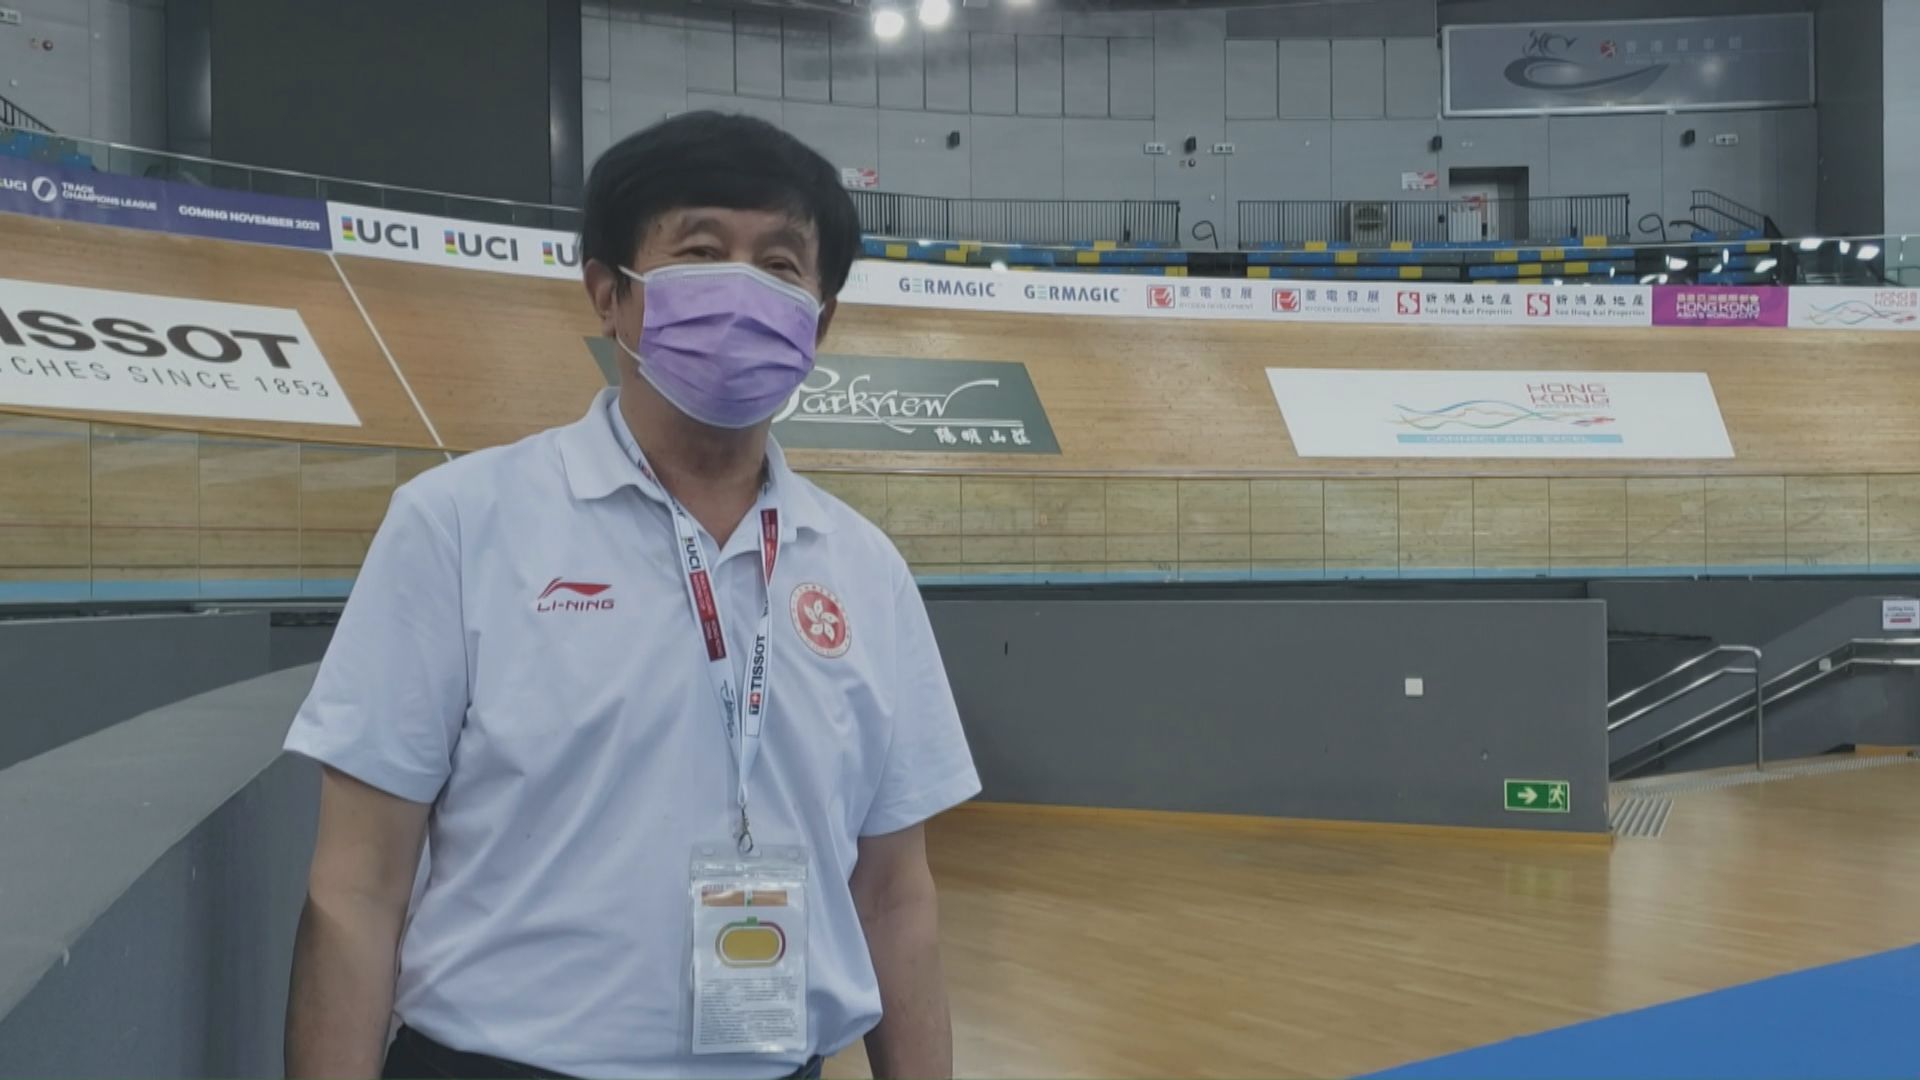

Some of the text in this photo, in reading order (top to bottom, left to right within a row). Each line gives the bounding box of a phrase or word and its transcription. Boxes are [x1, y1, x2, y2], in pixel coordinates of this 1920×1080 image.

[62, 182, 95, 193] TRACK
[62, 190, 157, 211] CHAMPIONS LEAGUE
[179, 205, 320, 232] COMING NOVEMBER 2021
[357, 218, 419, 250] UCI
[458, 232, 519, 262] UCI
[899, 277, 997, 298] GERMAGIC
[1024, 284, 1121, 303] GERMAGIC
[1476, 307, 1513, 316] Properties
[1676, 302, 1760, 313] HONG KONG
[0, 356, 330, 398] CHES SINCE 1853
[1526, 383, 1605, 393] HONG
[1531, 394, 1609, 404] KONG
[686, 543, 701, 571] UCI
[537, 599, 615, 612] LI-NING
[750, 634, 766, 691] TISSOT
